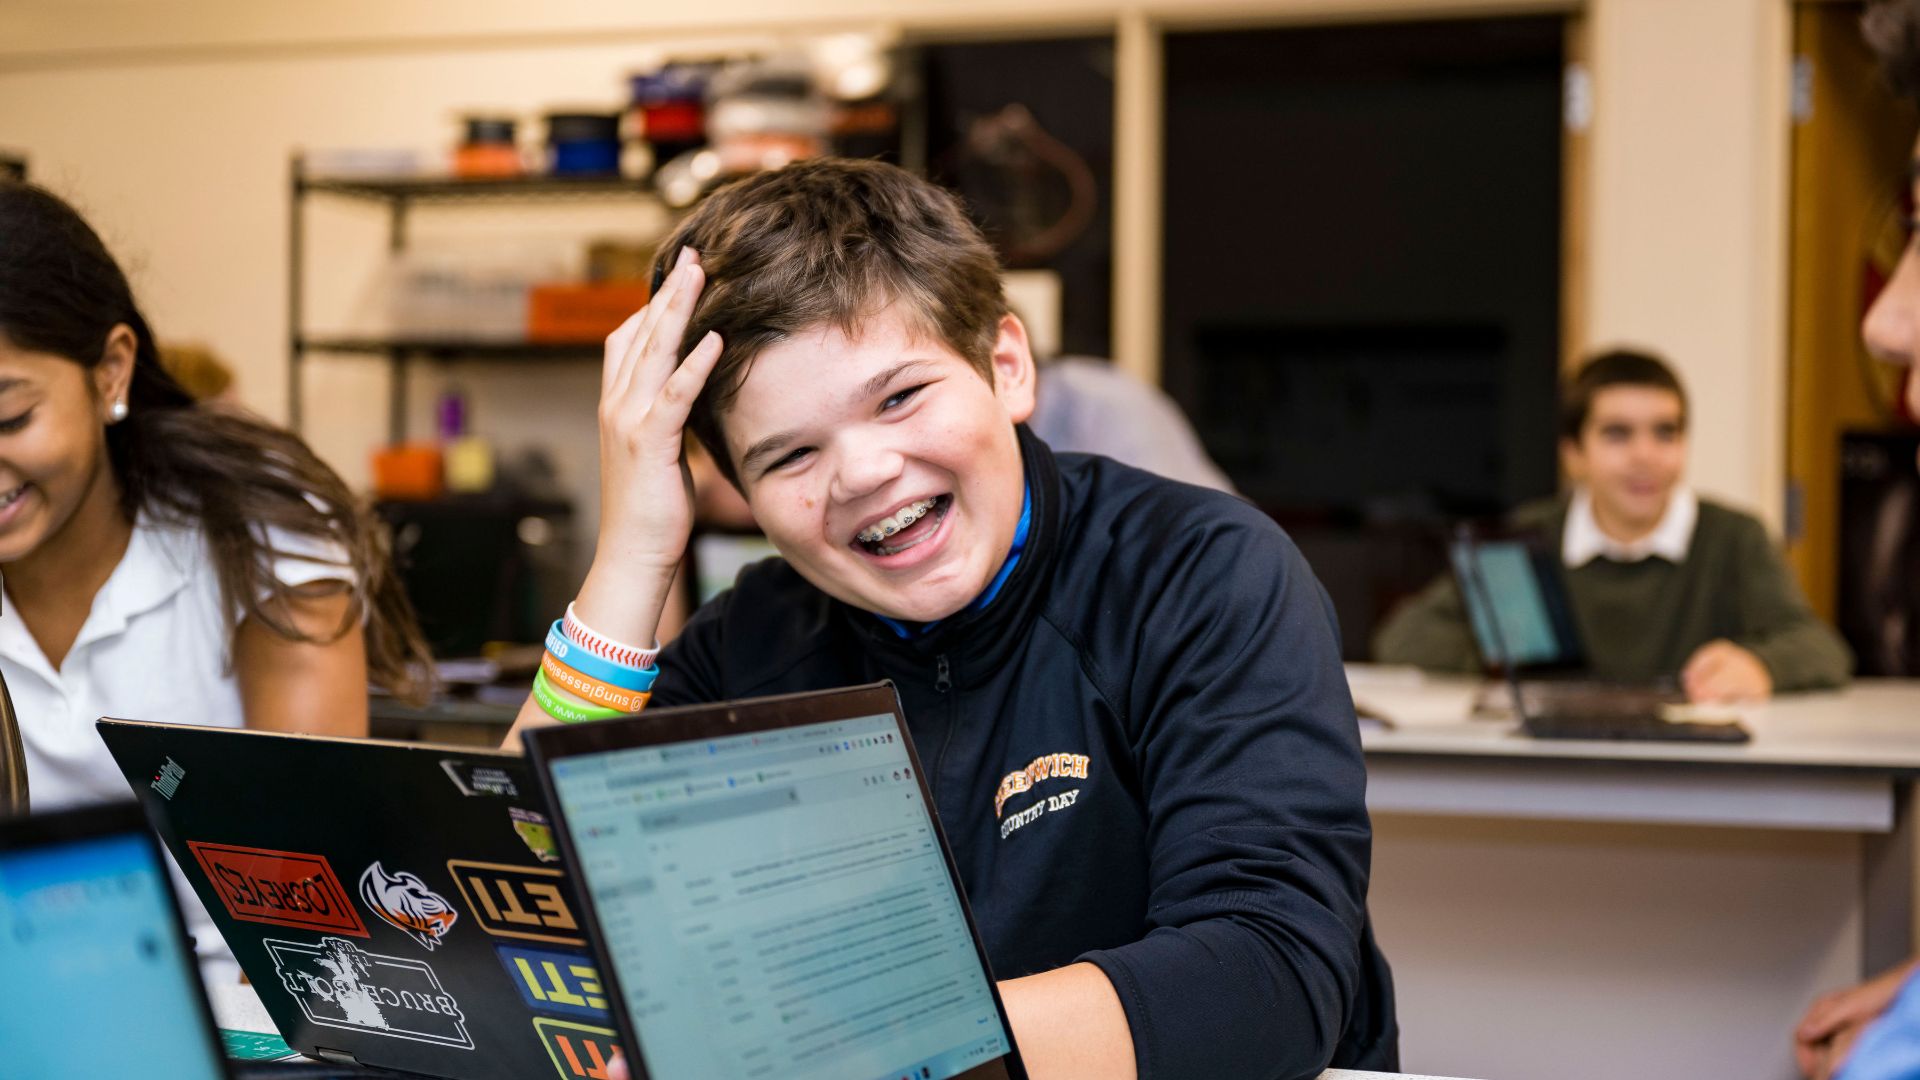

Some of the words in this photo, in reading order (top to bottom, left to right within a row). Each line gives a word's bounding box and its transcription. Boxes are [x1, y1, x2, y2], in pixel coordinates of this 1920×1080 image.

[150, 755, 186, 801] ThinkPad
[1047, 789, 1080, 812] DAY
[214, 861, 345, 918] LOSREYES
[468, 876, 579, 930] ETI
[325, 950, 372, 968] TEXAS
[328, 940, 355, 953] USA
[362, 983, 456, 1017] BRUCE
[513, 957, 610, 1010] ETI
[555, 1034, 622, 1080] TI
